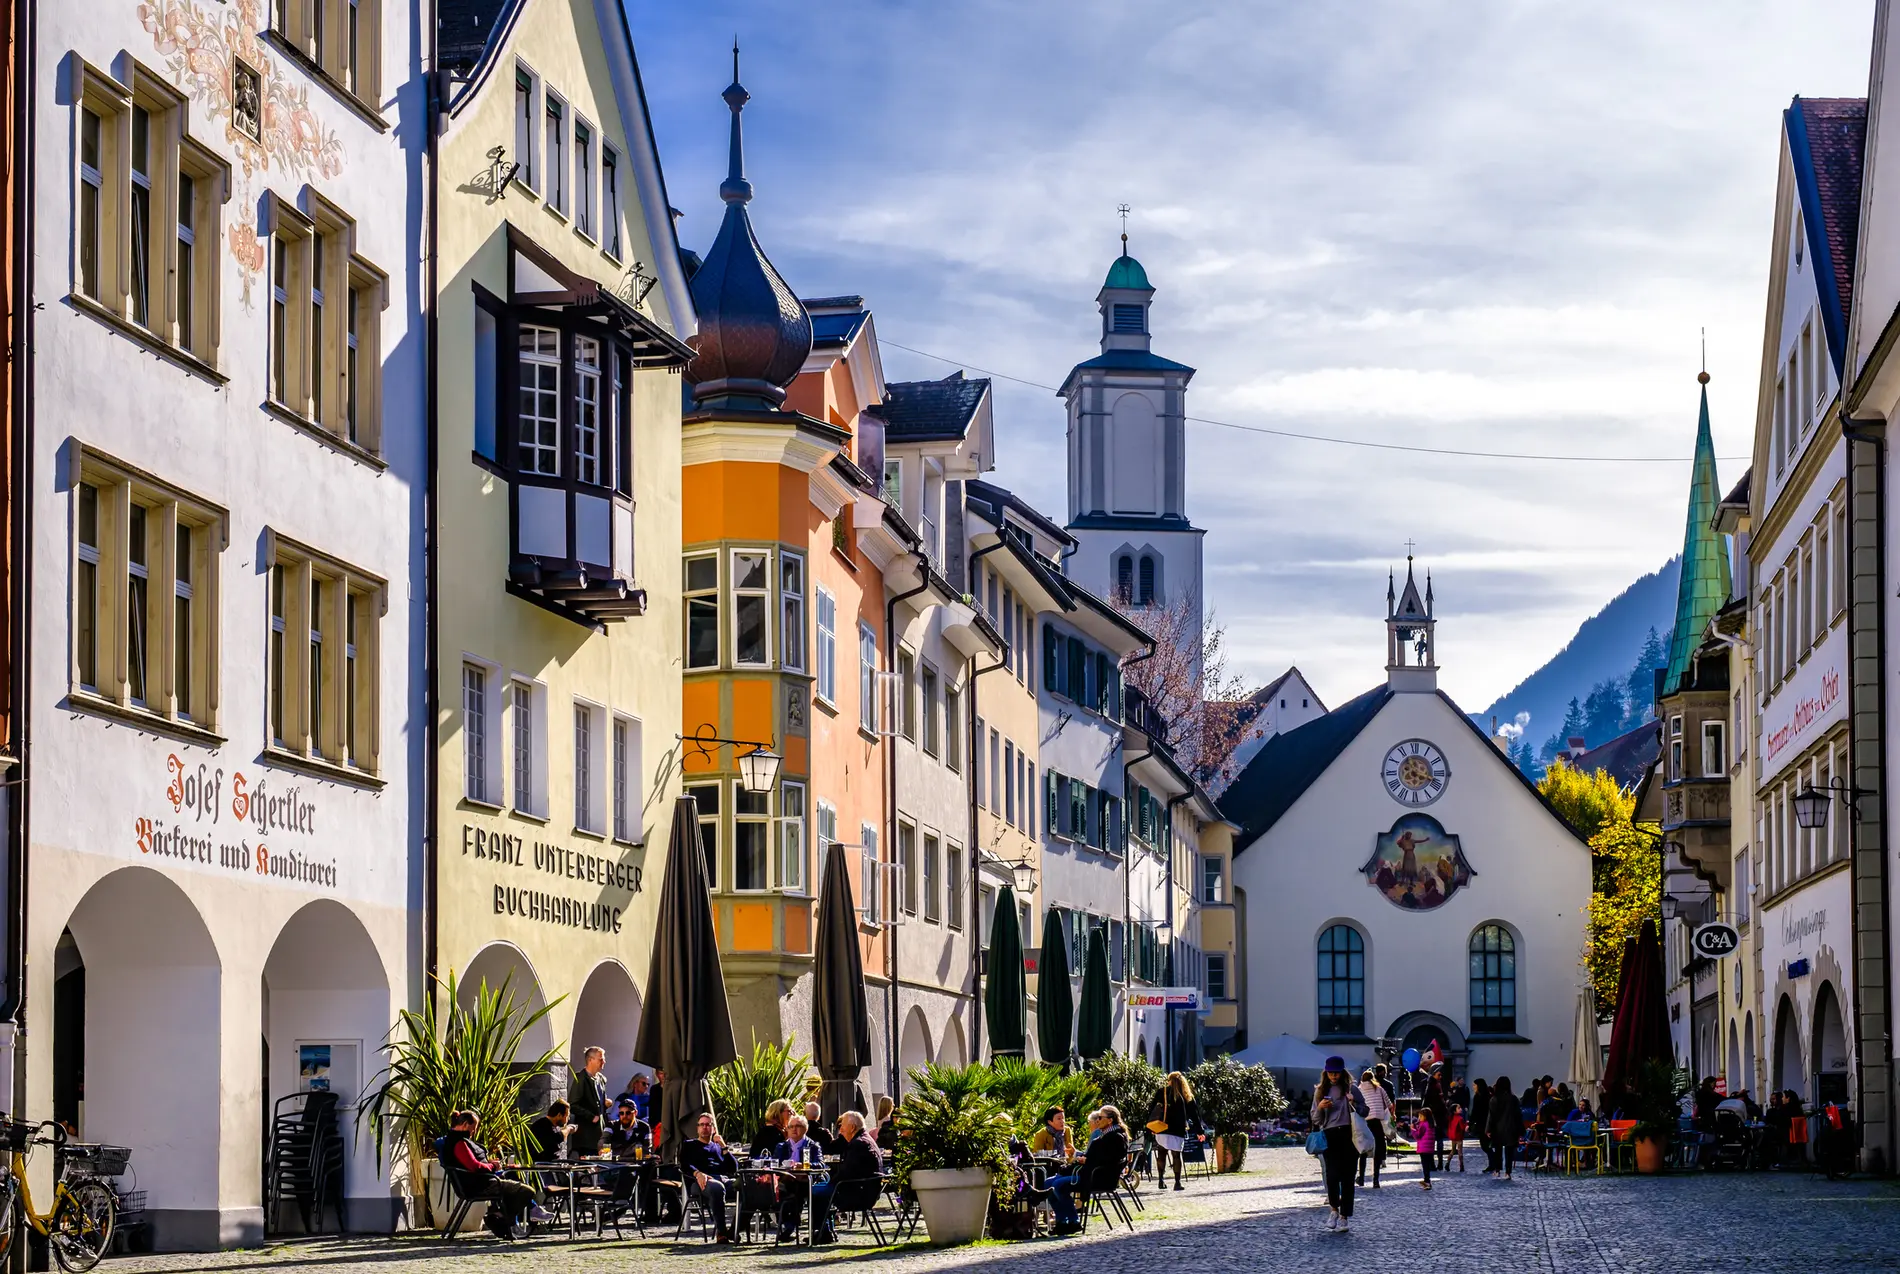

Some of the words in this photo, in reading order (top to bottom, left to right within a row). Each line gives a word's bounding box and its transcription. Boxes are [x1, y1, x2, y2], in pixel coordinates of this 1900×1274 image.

[167, 753, 224, 824] Josef
[135, 816, 213, 865] Bäckerei
[219, 838, 251, 872] und
[256, 842, 337, 889] Konditorei
[462, 823, 524, 867] FRANZ
[533, 841, 643, 893] UNTERBERGER
[493, 883, 622, 934] BUCHHANDLUNG
[1700, 931, 1734, 949] C&A
